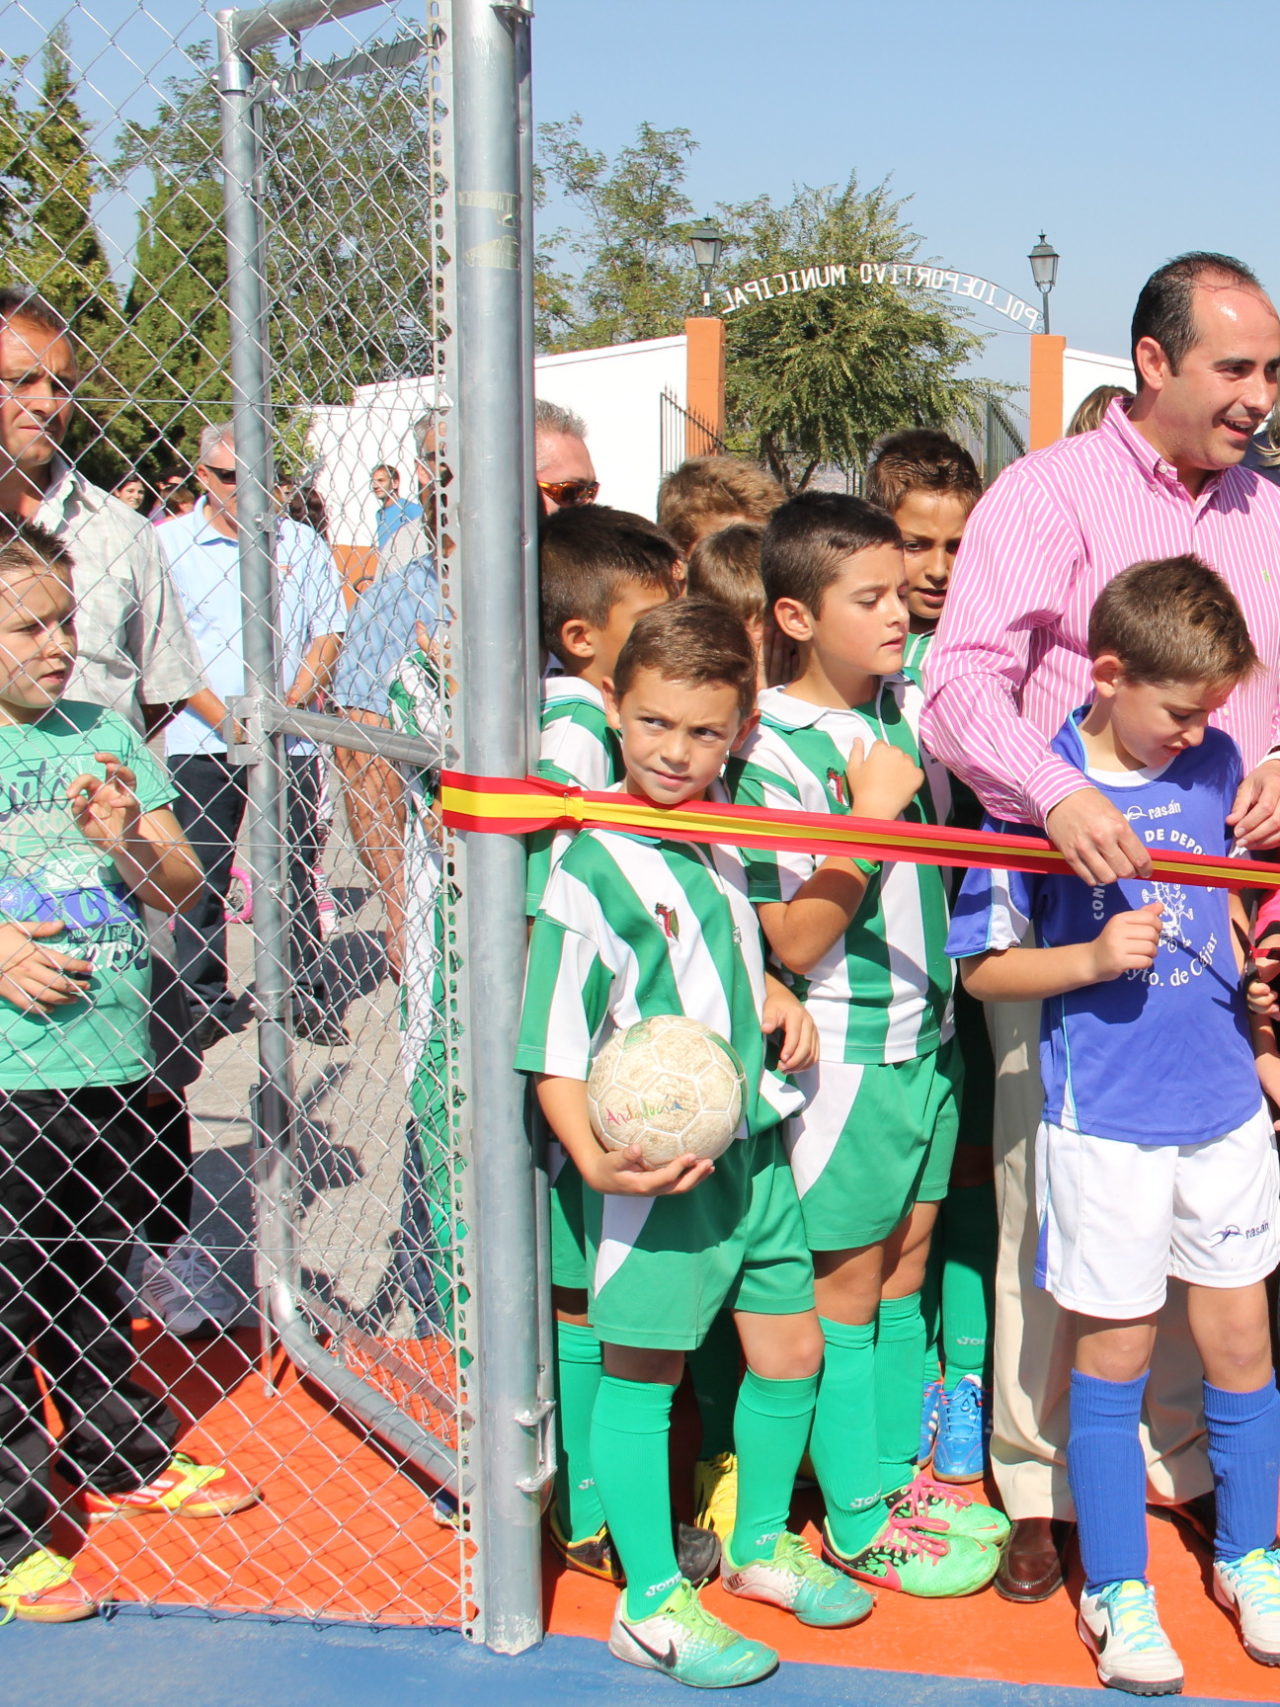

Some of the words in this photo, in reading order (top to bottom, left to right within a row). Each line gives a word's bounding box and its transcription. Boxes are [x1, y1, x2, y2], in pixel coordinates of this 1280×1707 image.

[1148, 800, 1181, 820] rasán
[1144, 828, 1165, 842] DE
[1170, 967, 1190, 986] de
[1190, 932, 1218, 976] Cájar
